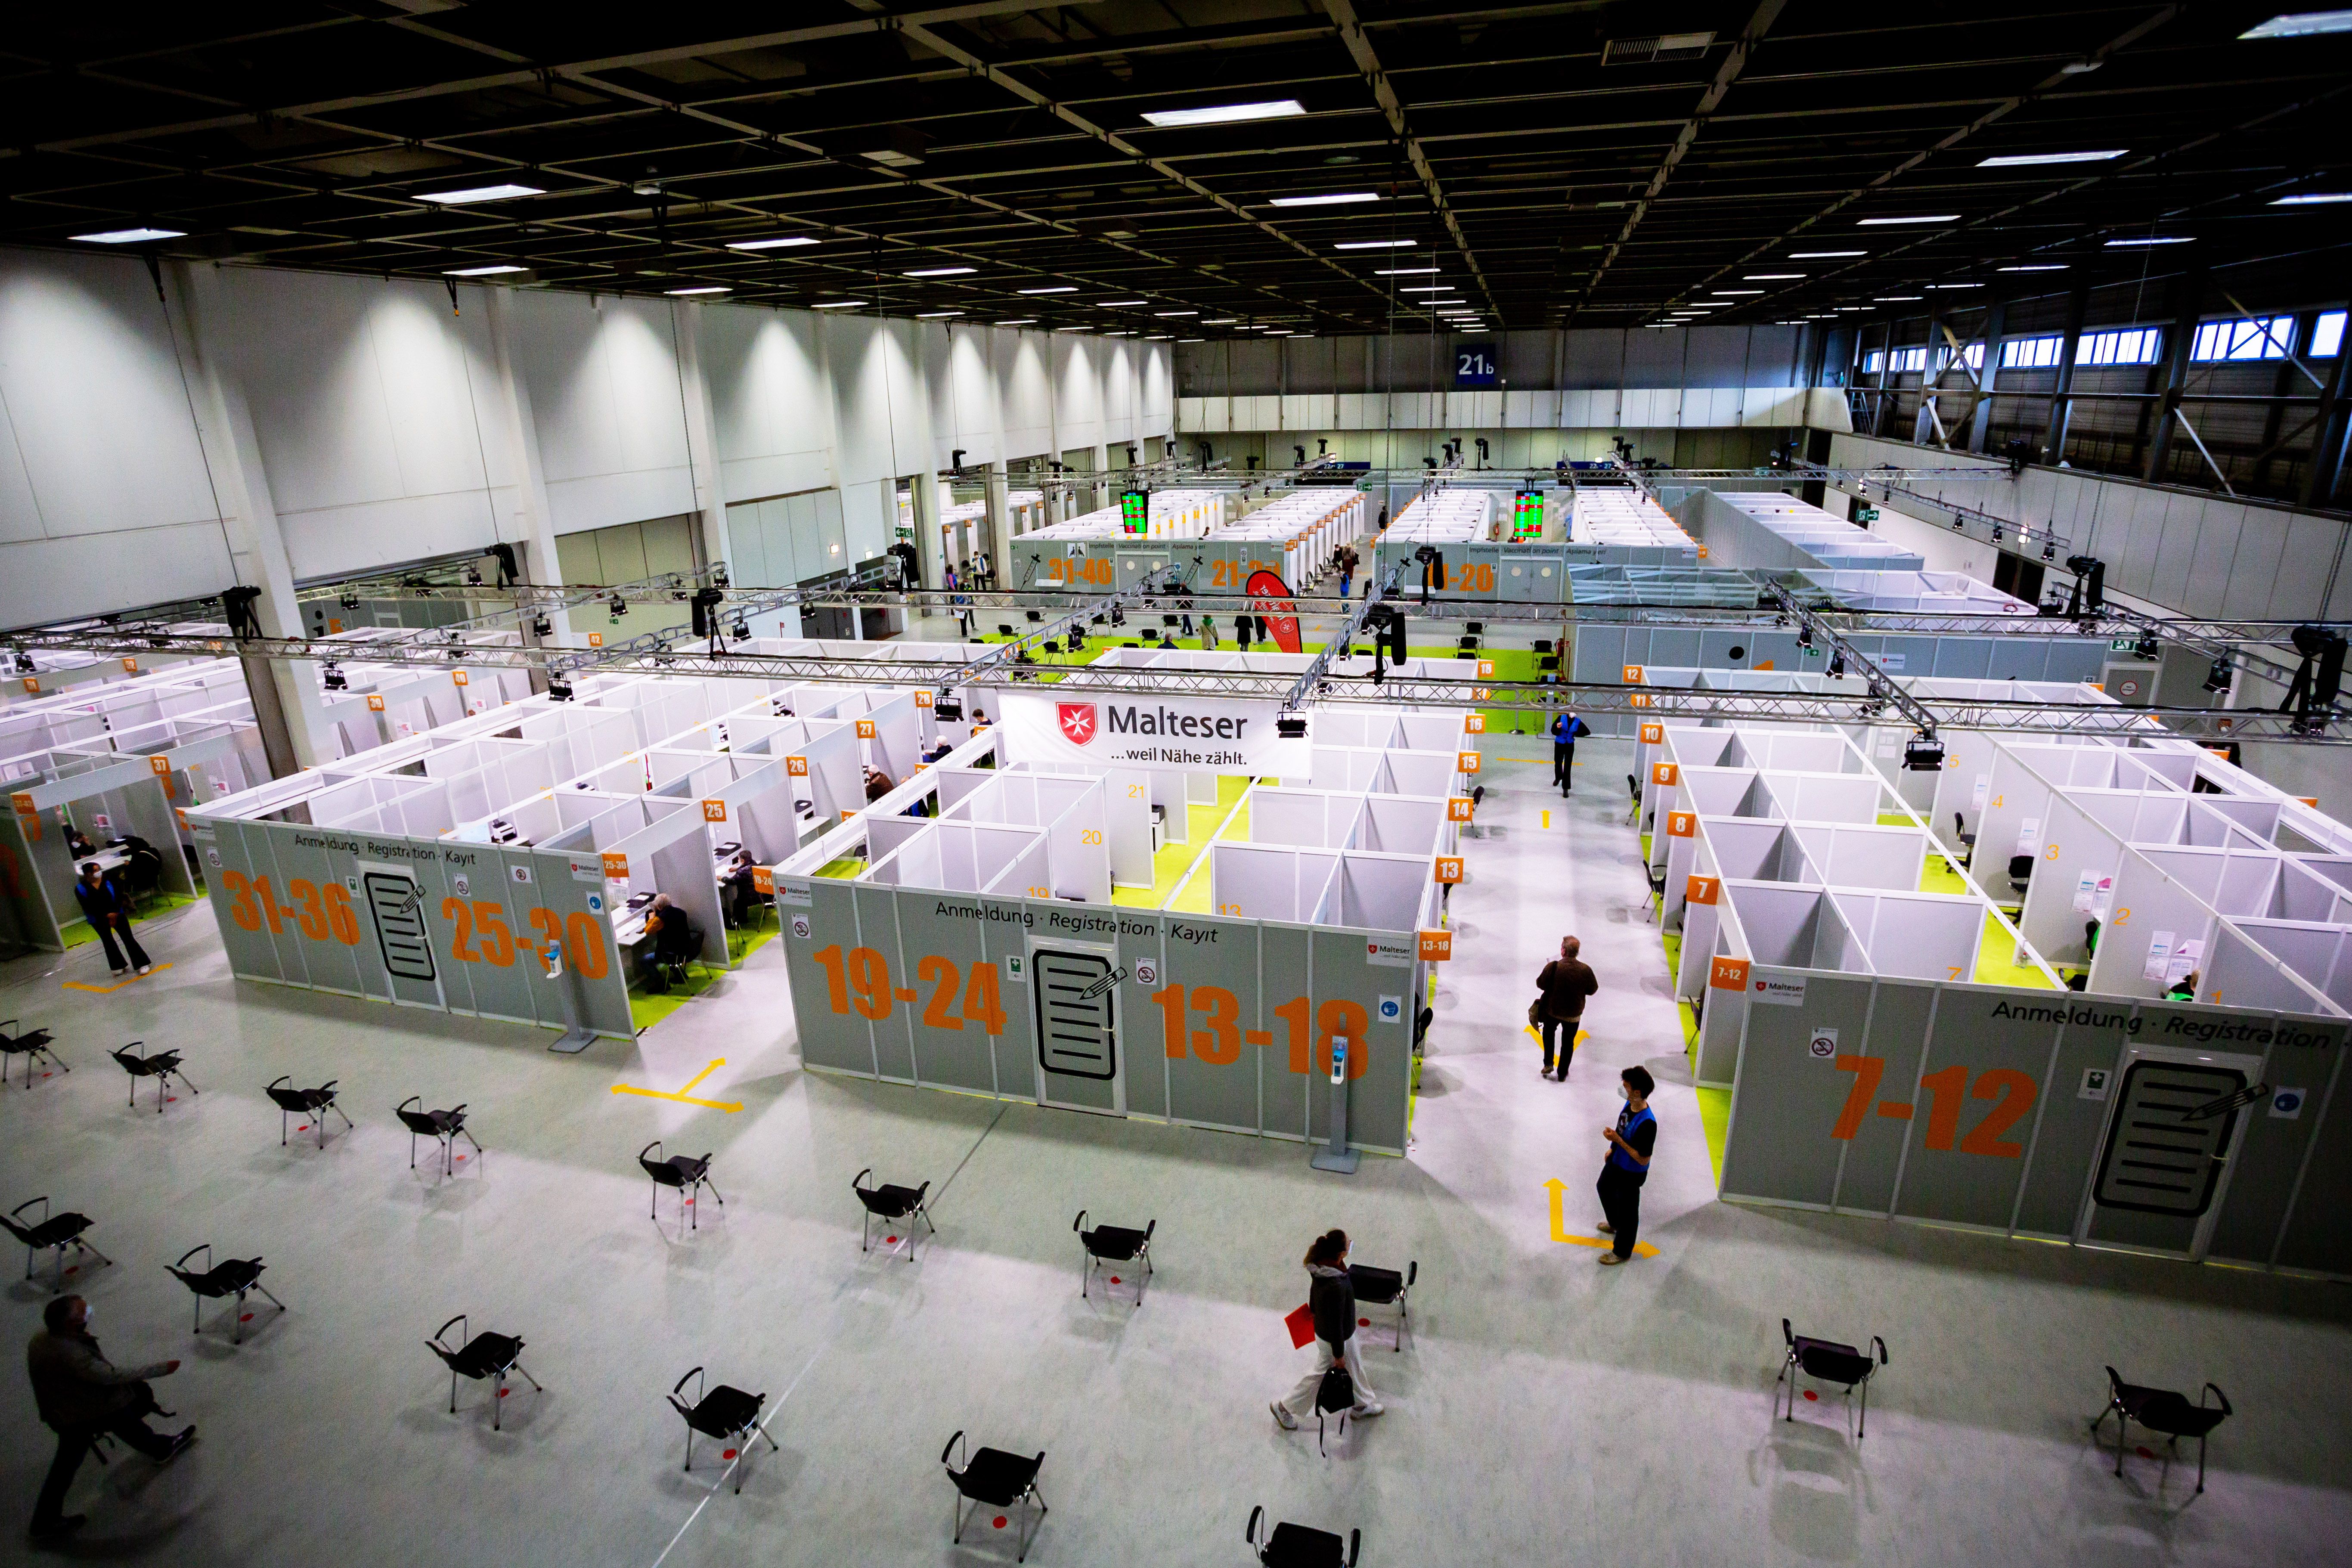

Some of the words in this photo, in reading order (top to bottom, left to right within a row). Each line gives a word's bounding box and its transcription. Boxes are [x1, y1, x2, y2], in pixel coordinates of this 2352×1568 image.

[1049, 558, 1112, 585] 31-40
[590, 635, 601, 645] 42
[1481, 664, 1492, 674] 18
[1626, 669, 1638, 679] 12
[455, 673, 467, 684] 40
[371, 698, 381, 708] 39
[917, 693, 930, 704] 28
[1635, 695, 1647, 707] 11
[1109, 705, 1248, 739] Malteser
[1469, 718, 1482, 730] 16
[859, 724, 871, 735] 27
[1645, 728, 1658, 741] 10
[1162, 749, 1202, 763] Nähe
[1206, 751, 1247, 765] zählt.
[1462, 756, 1477, 769] 15
[1949, 755, 1960, 768] 5
[154, 759, 166, 771] 37
[789, 759, 806, 773] 26
[1660, 767, 1670, 781] 9
[1128, 785, 1145, 798] 21
[1992, 795, 2004, 809] 4
[706, 803, 723, 818] 25
[1453, 803, 1469, 817] 14
[1676, 817, 1686, 832] 8
[1081, 830, 1102, 845] 20
[295, 834, 359, 855] Anmeldung
[368, 842, 435, 862] Registration
[445, 850, 476, 867] Kayıt
[2046, 845, 2059, 861] 3
[604, 861, 626, 869] 25-30
[1440, 862, 1459, 879] 13
[754, 875, 772, 886] 19-24
[1028, 886, 1048, 898] 19
[1698, 882, 1707, 898] 7
[222, 871, 361, 945] 31-36
[936, 902, 1034, 927] Anmeldung
[1050, 912, 1155, 936] Registration
[1171, 923, 1218, 943] Kayıt
[2113, 908, 2130, 925] 2
[442, 897, 609, 979] 25-30
[1422, 940, 1449, 952] 13-18
[1718, 967, 1742, 981] 7-12
[1948, 967, 1962, 981] 7
[814, 944, 1007, 1035] 19-24
[1769, 983, 1804, 992] Malteser
[2211, 990, 2222, 1005] 1
[1152, 983, 1369, 1080] 13-18
[1992, 1001, 2142, 1035] Anmeldung
[2165, 1017, 2331, 1049] Registration
[1830, 1055, 2038, 1159] 7-12
